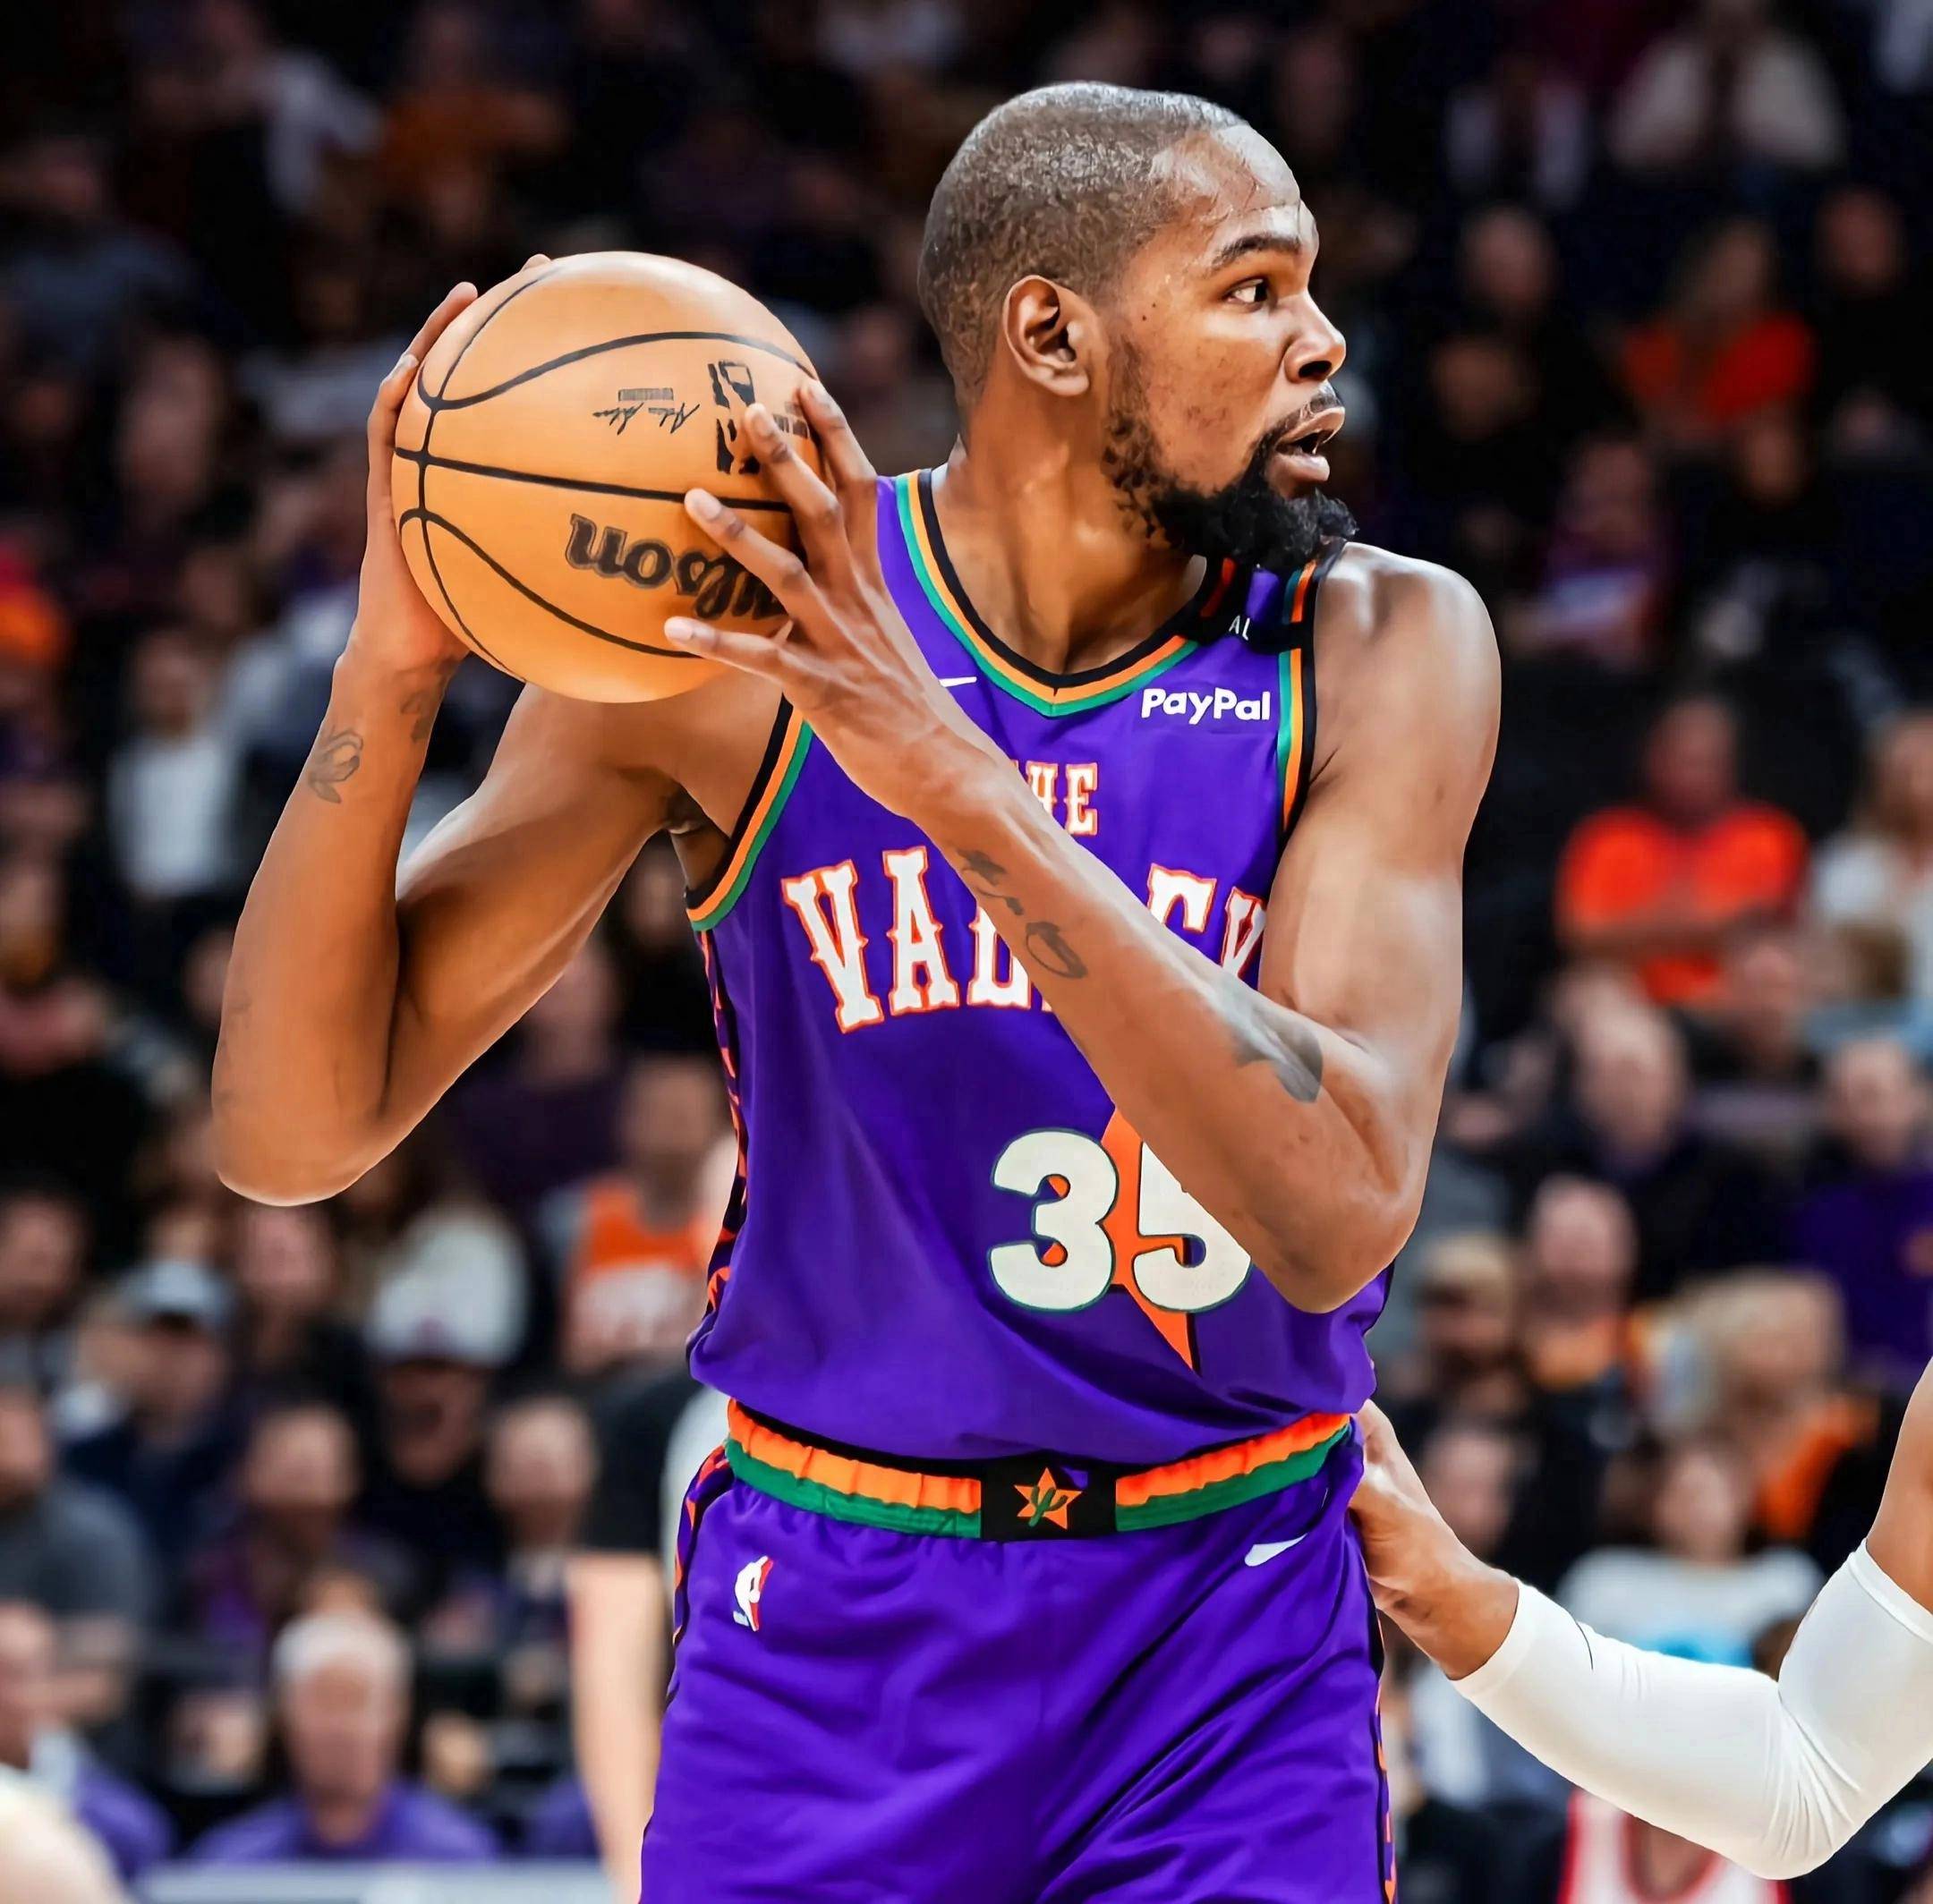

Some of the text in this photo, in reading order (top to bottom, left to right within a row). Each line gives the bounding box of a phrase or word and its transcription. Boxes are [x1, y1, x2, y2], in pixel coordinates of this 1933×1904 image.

[565, 513, 789, 620] ilson
[1140, 687, 1271, 725] PayPal
[1010, 760, 1098, 836] HE
[988, 1126, 1254, 1313] 35
